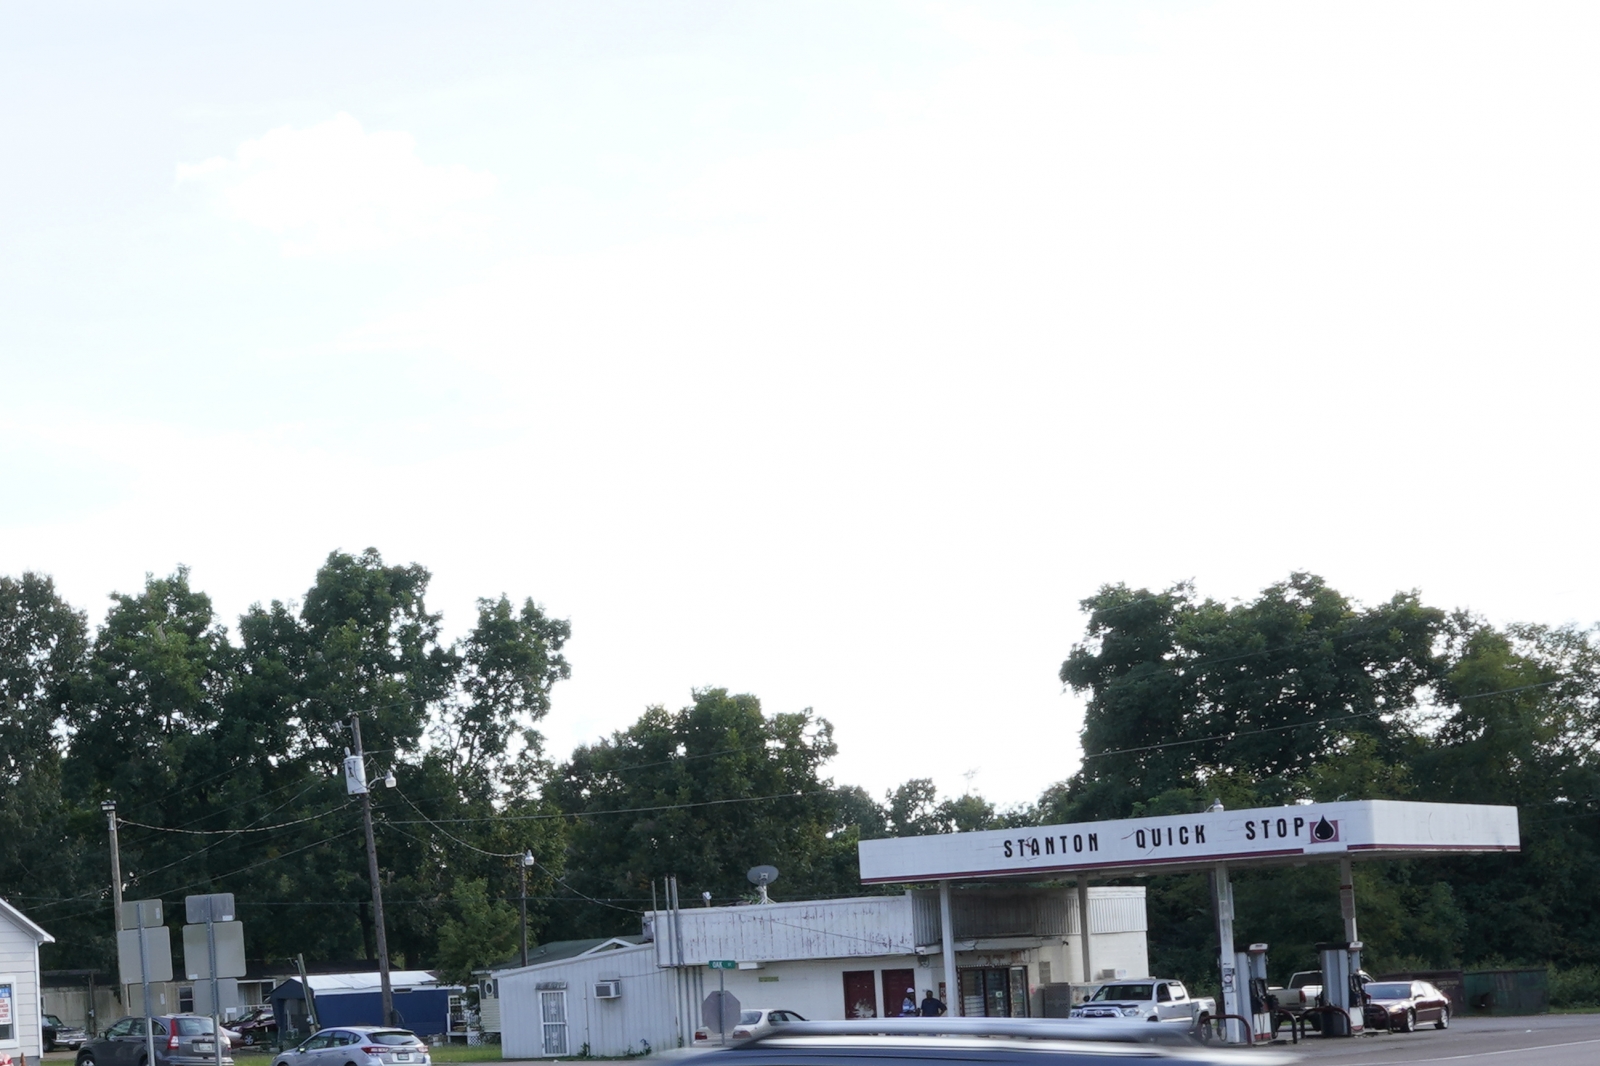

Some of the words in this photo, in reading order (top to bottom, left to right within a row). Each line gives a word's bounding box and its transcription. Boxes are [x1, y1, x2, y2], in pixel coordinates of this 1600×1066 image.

[1004, 833, 1099, 857] STANTON
[1135, 824, 1206, 848] QUICK
[1245, 816, 1305, 840] STOP
